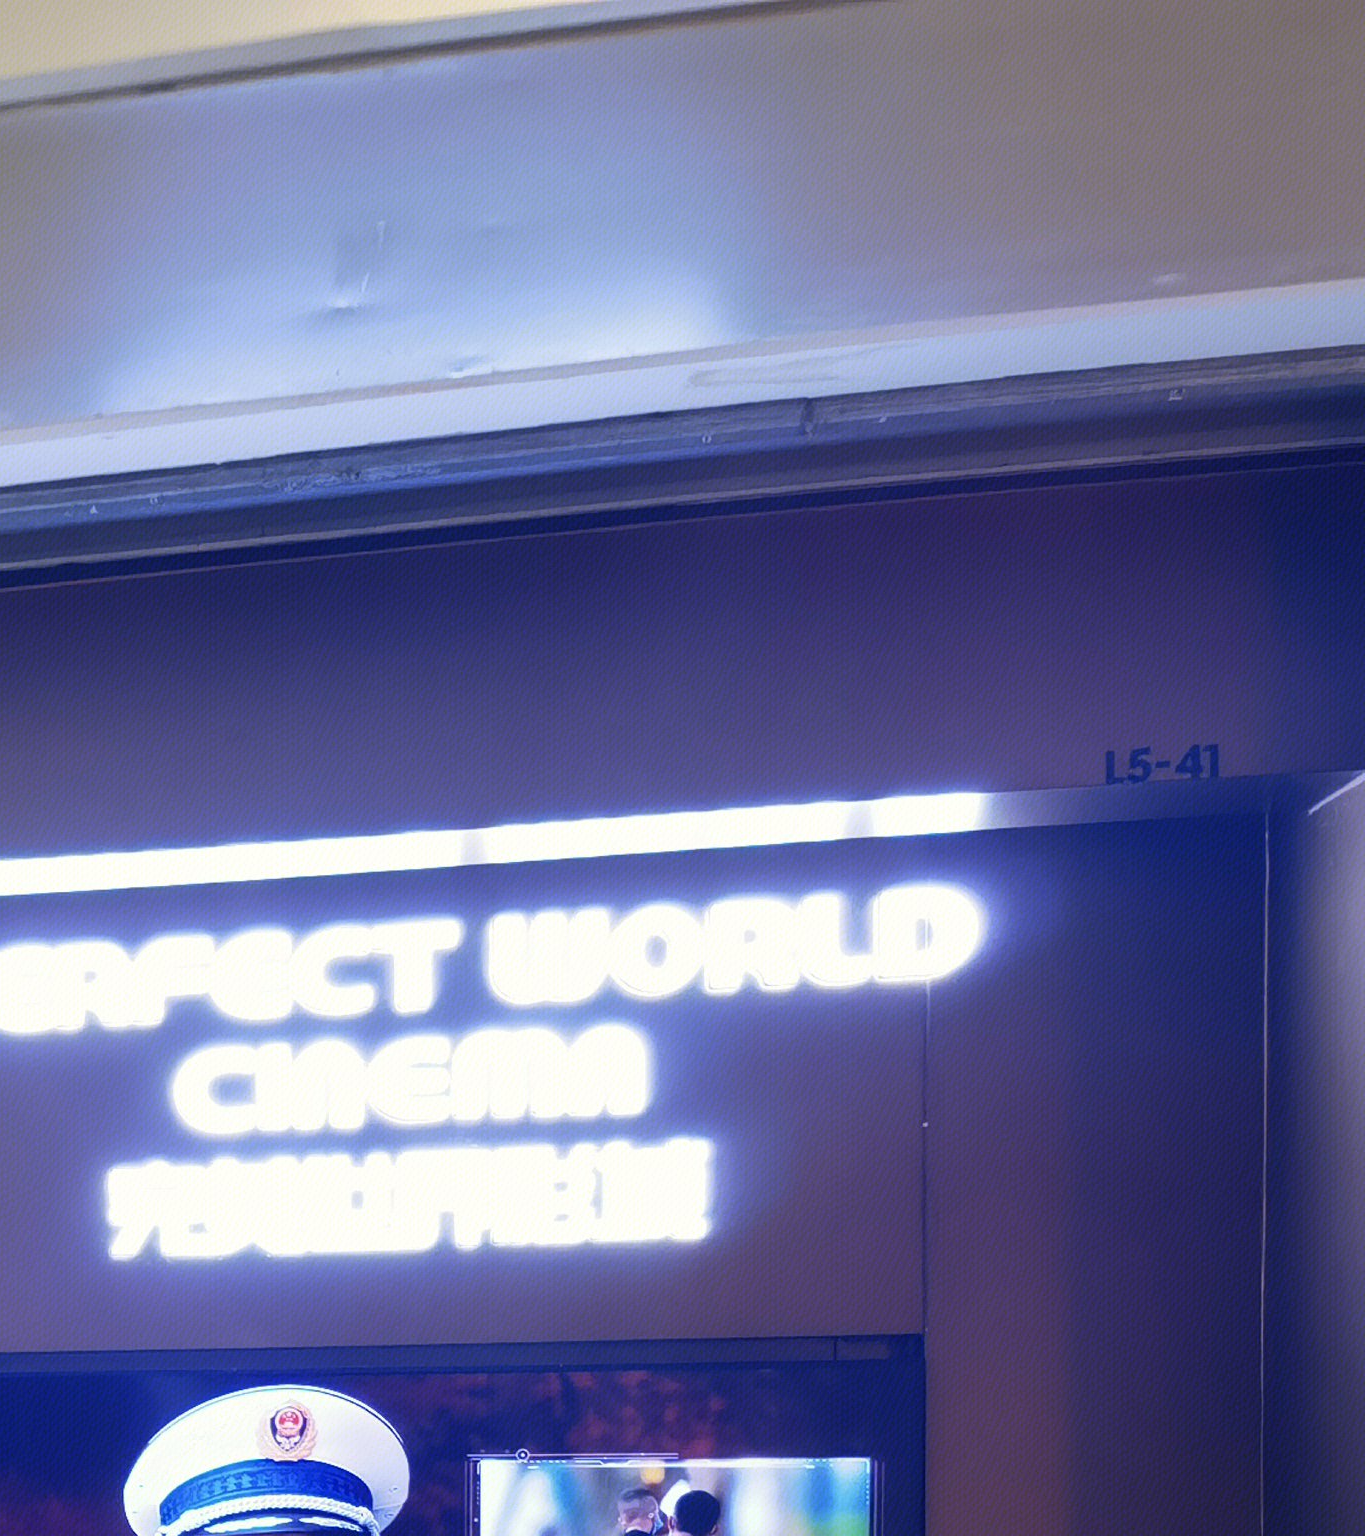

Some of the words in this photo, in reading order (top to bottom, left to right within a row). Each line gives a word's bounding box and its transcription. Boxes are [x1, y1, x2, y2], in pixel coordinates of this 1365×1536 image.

[1105, 743, 1220, 785] L5-41
[484, 882, 984, 1009] WORLD
[169, 1023, 651, 1135] CINEMA
